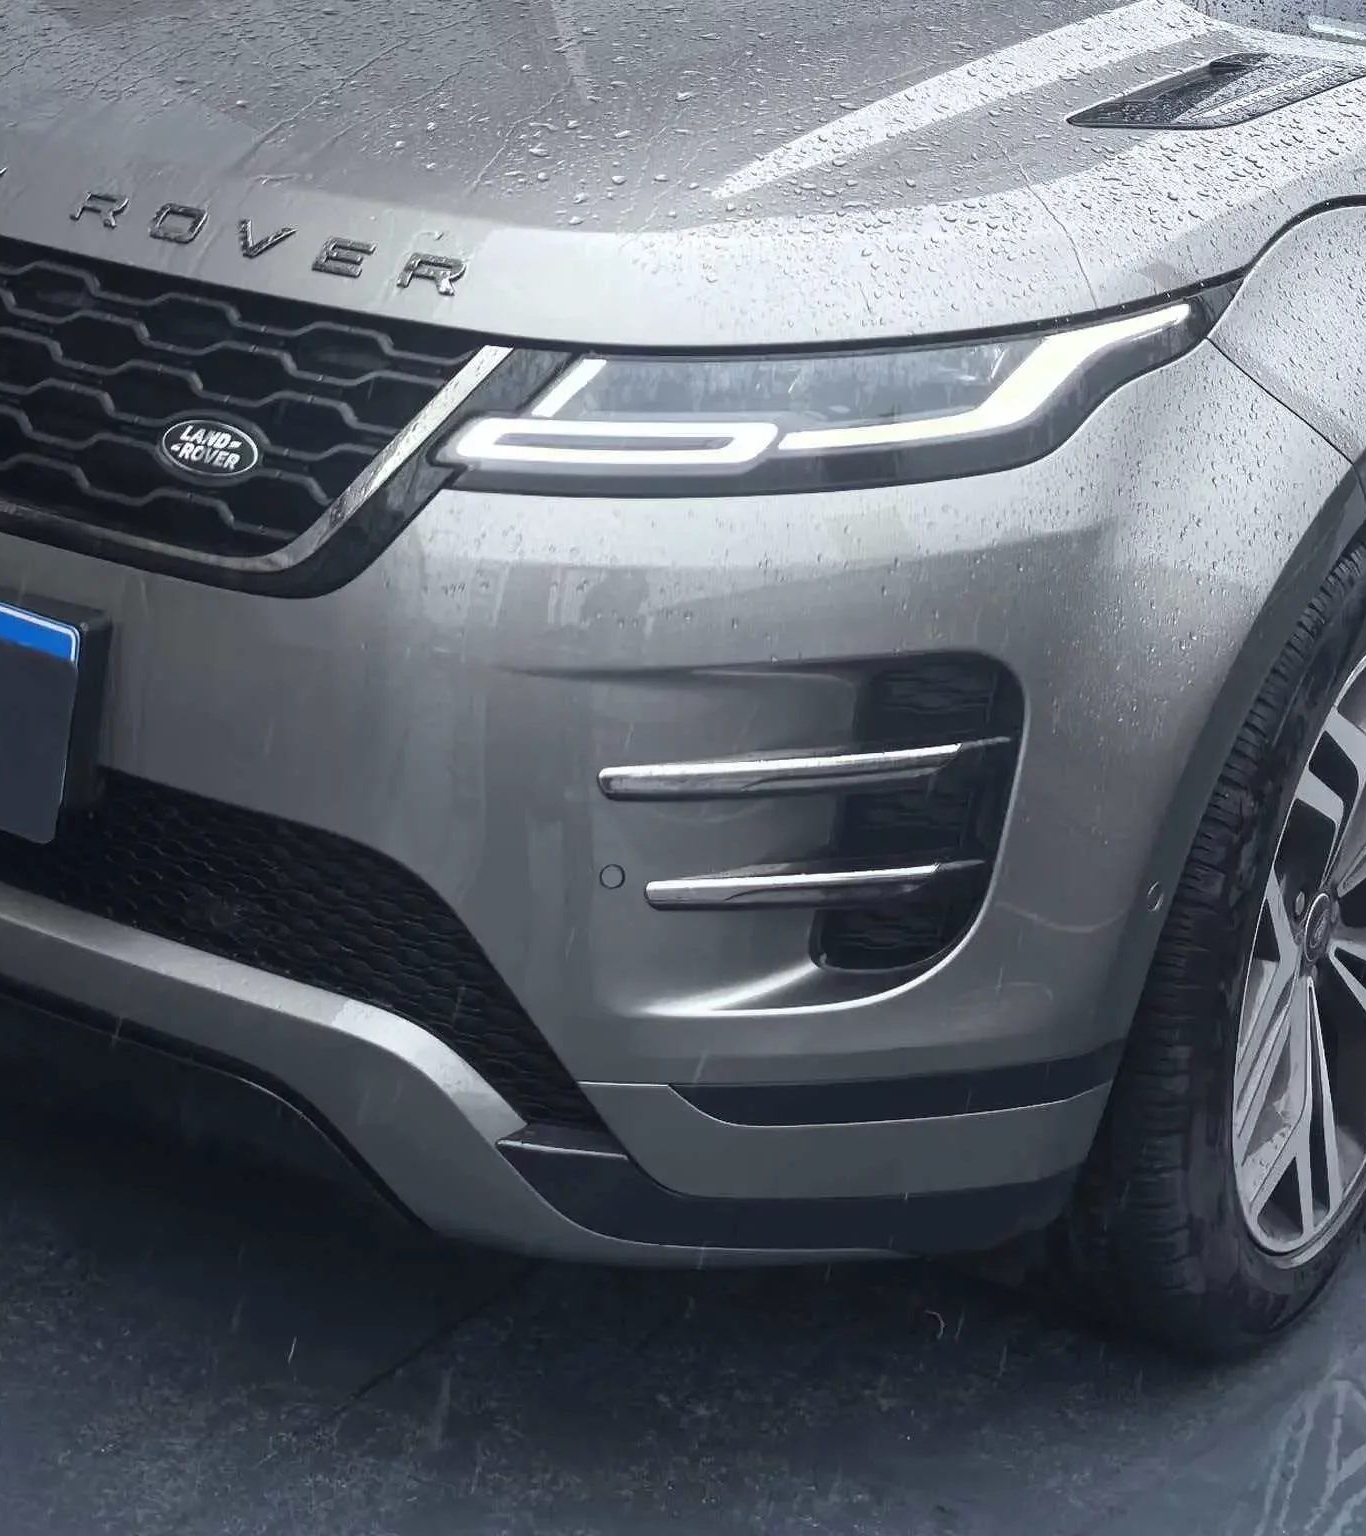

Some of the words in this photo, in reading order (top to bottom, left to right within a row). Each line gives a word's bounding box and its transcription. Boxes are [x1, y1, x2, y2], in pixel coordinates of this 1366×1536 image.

[69, 191, 471, 297] ROVER
[179, 425, 233, 450] LAND
[178, 442, 241, 471] ROVER
